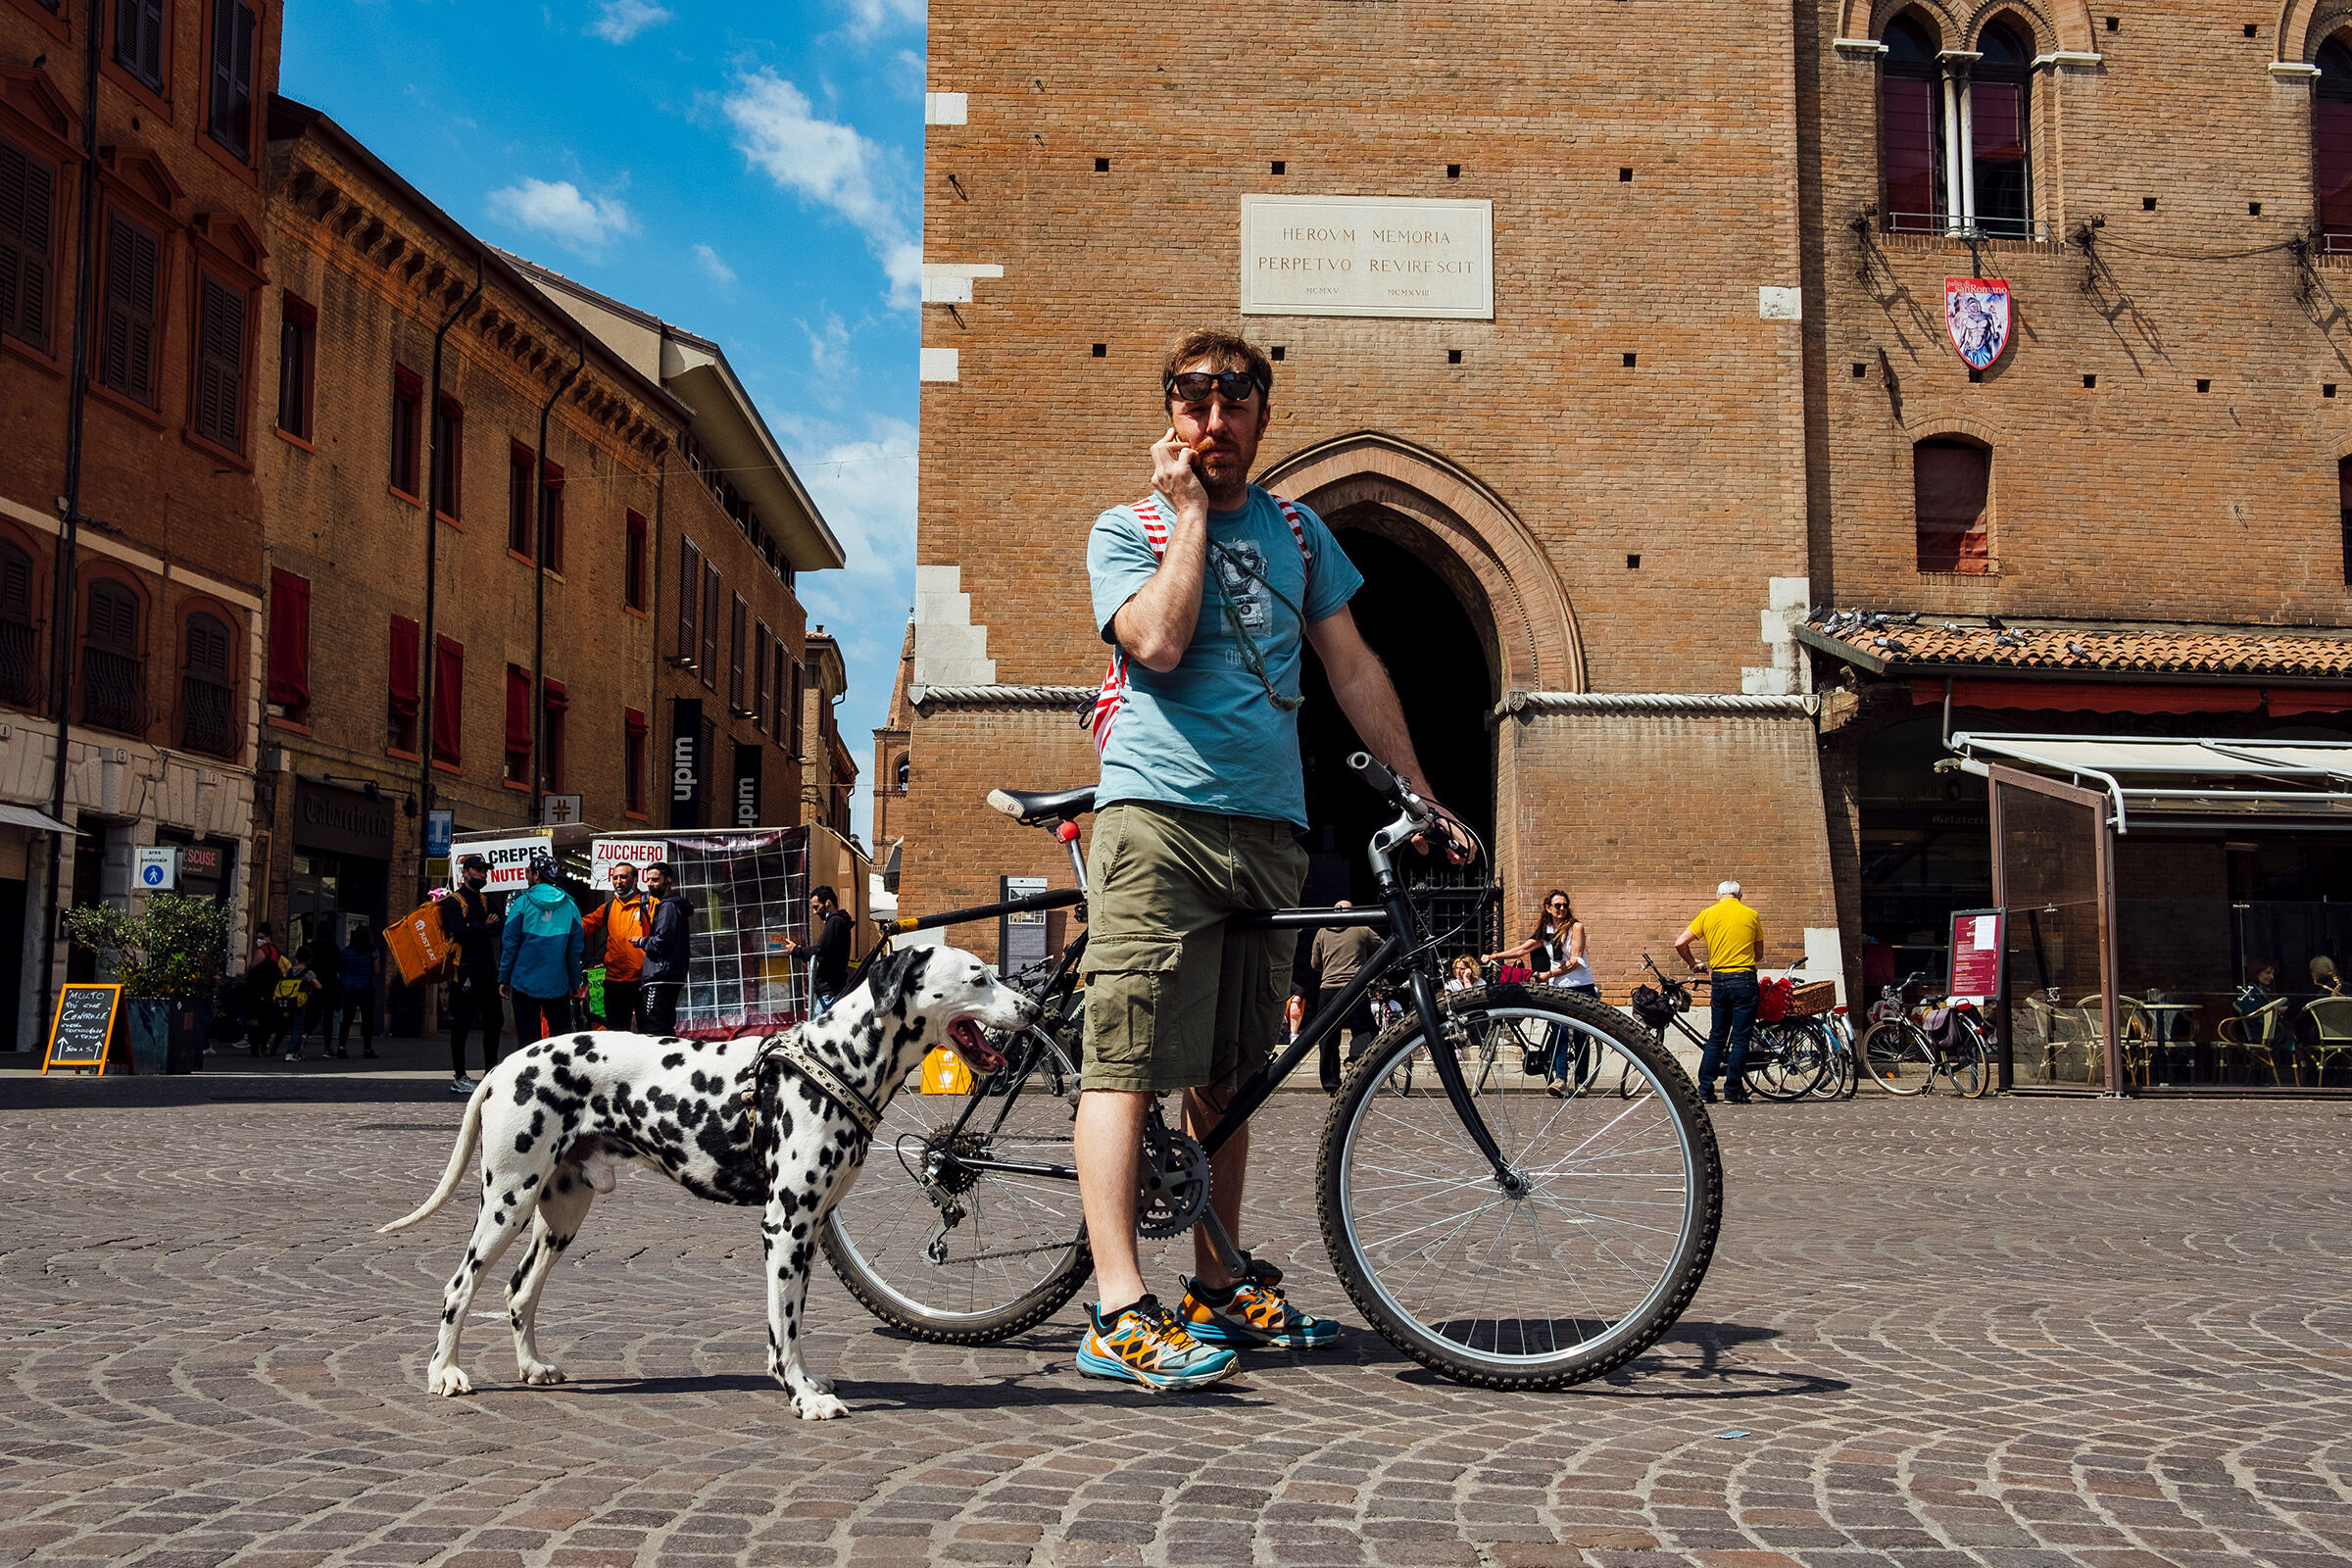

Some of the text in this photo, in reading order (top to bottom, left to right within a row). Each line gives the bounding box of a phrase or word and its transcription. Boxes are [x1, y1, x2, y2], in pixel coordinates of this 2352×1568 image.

[1283, 227, 1450, 244] HEROVM MEMORIA
[1258, 257, 1475, 273] PERPETVO REVIRESCIT
[673, 737, 698, 801] upim
[305, 792, 389, 837] Tabaccheria
[738, 777, 759, 829] upim
[488, 846, 547, 864] CREPES
[598, 844, 662, 861] ZUCCHERO
[419, 931, 437, 961] JUST EAT
